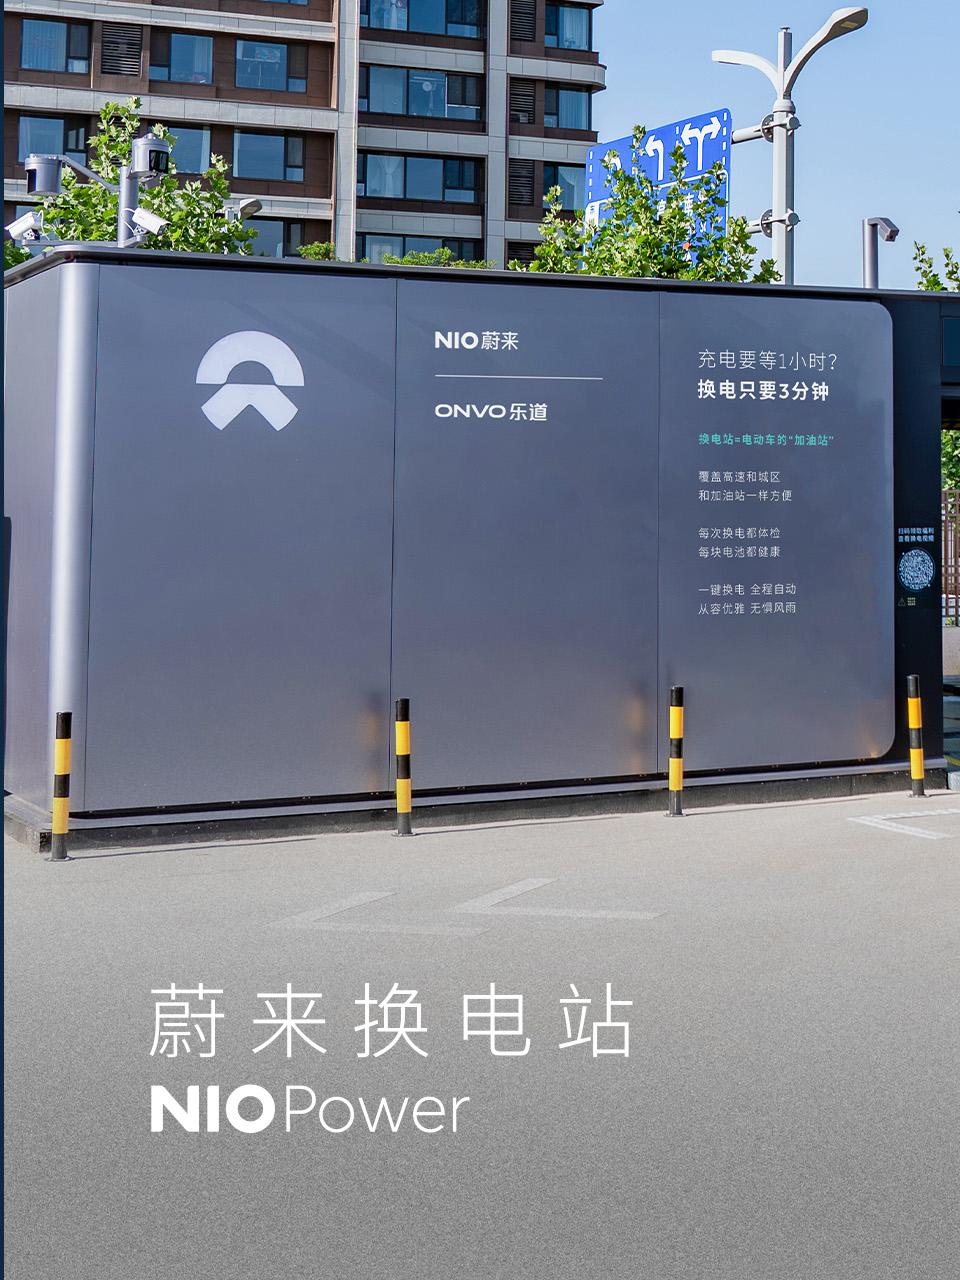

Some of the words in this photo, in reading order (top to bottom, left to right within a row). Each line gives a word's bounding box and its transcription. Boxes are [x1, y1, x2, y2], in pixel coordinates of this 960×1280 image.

[697, 378, 829, 402] 换电只要3分钟
[698, 470, 781, 483] 覆盖高速和城区
[698, 489, 792, 502] 和加油站一样方便
[698, 527, 781, 540] 每次换电都体检
[698, 546, 781, 559] 每块电池都健康
[698, 583, 745, 596] 一键换电
[750, 583, 797, 595] 全程自动
[698, 602, 745, 615] 从容优雅
[750, 601, 796, 614] 无惧风雨
